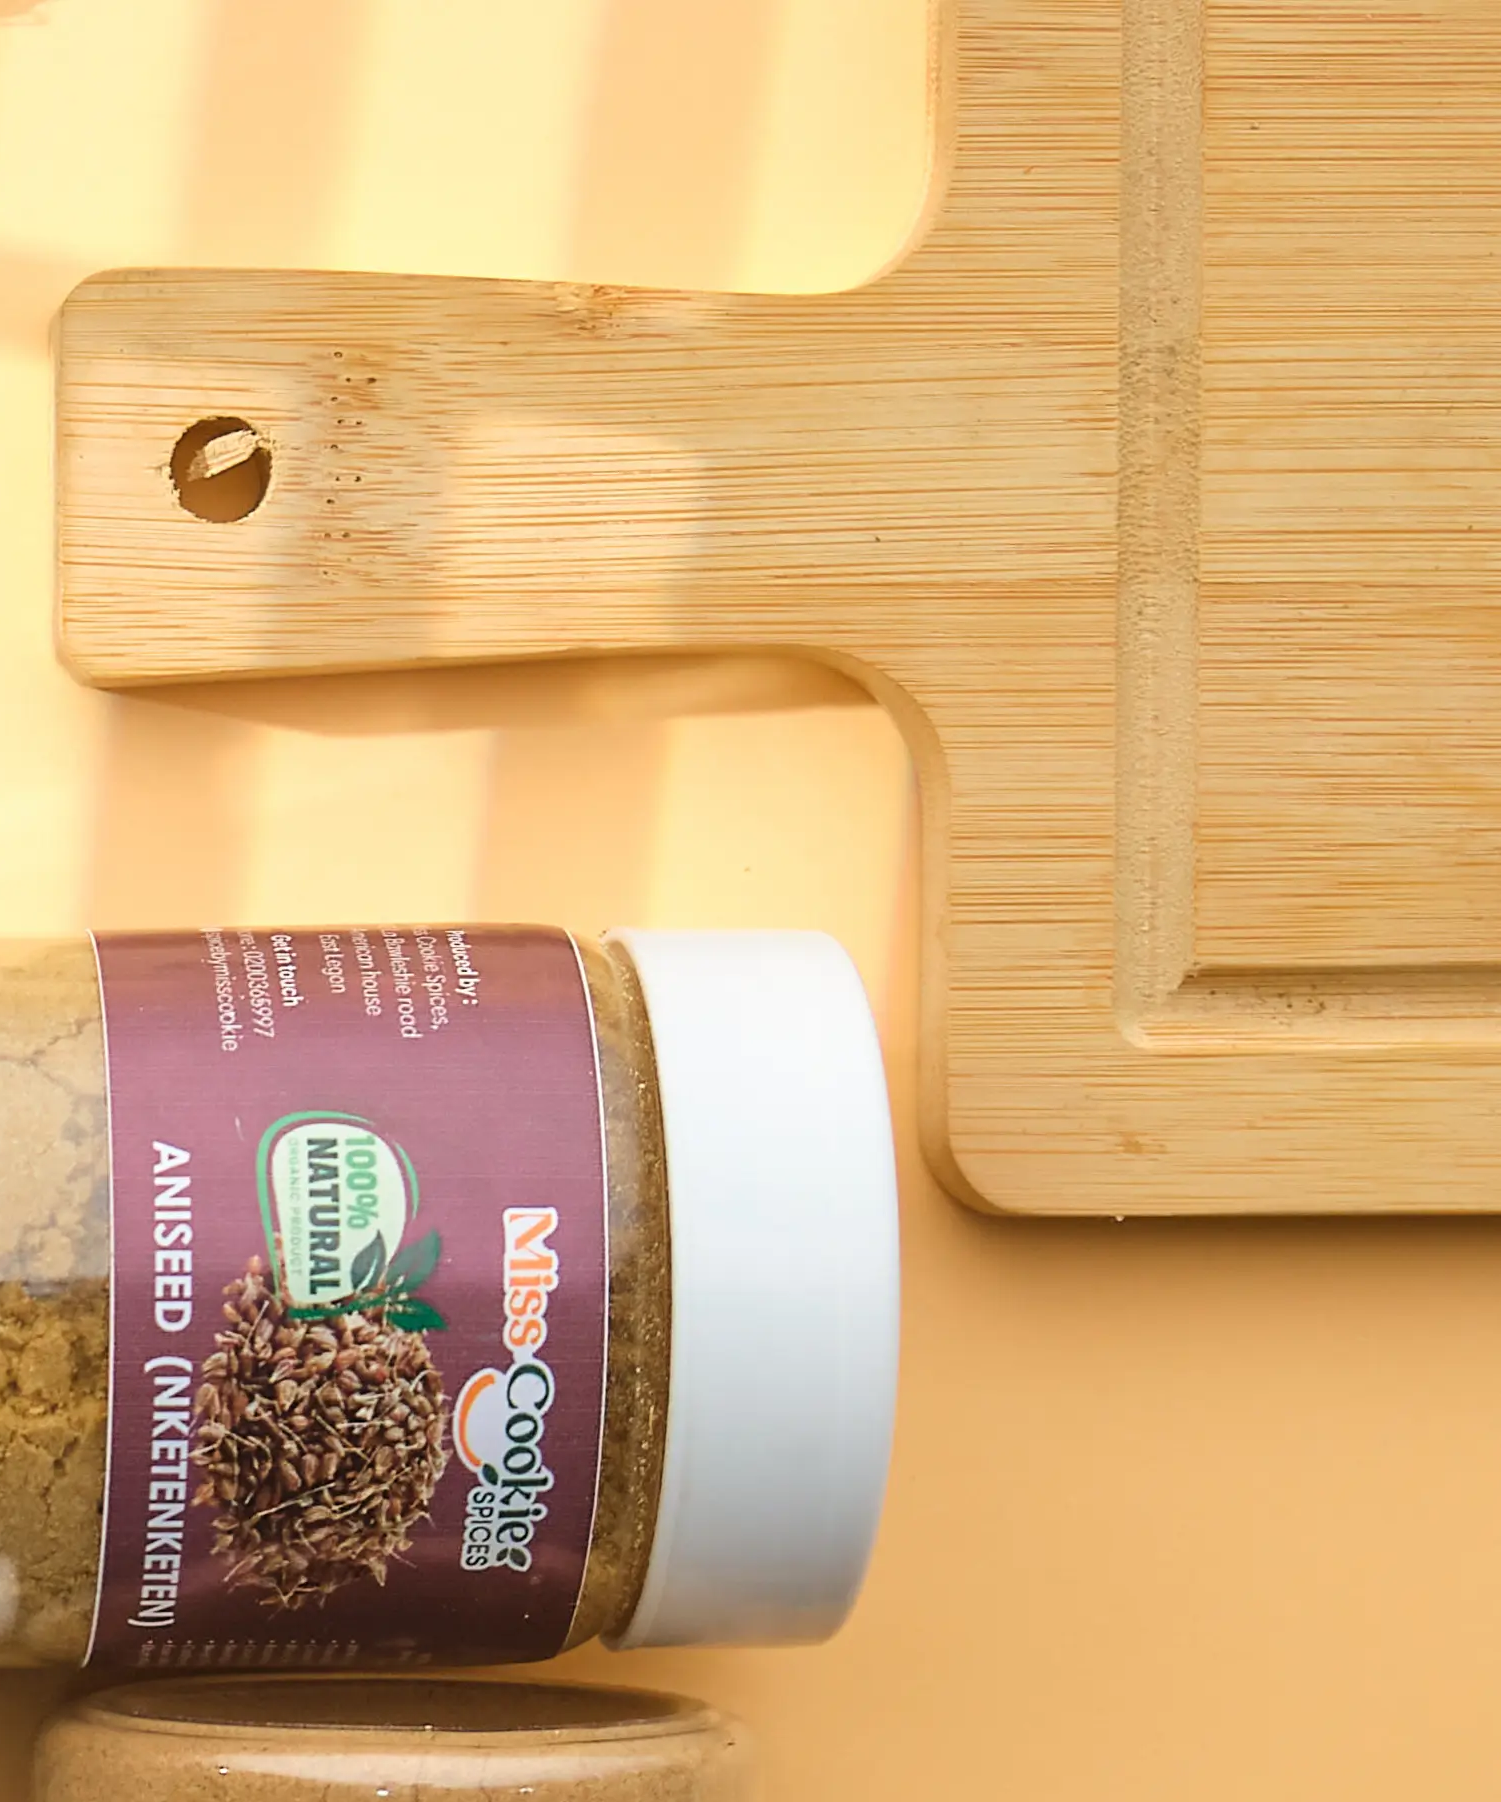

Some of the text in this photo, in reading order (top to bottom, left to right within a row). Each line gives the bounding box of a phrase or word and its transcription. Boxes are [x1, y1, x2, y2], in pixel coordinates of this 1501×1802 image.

[271, 935, 304, 1006] Get in touch
[416, 936, 444, 972] Cookie
[445, 931, 479, 975] Produced
[455, 978, 481, 996] by
[397, 998, 423, 1038] road
[307, 1138, 339, 1295] NATURAL
[345, 1136, 380, 1228] 100%
[127, 1141, 193, 1629] ANISEED (NKETENKETEN)
[496, 1213, 553, 1543] Miss Cookie
[465, 1492, 495, 1567] SPICES
